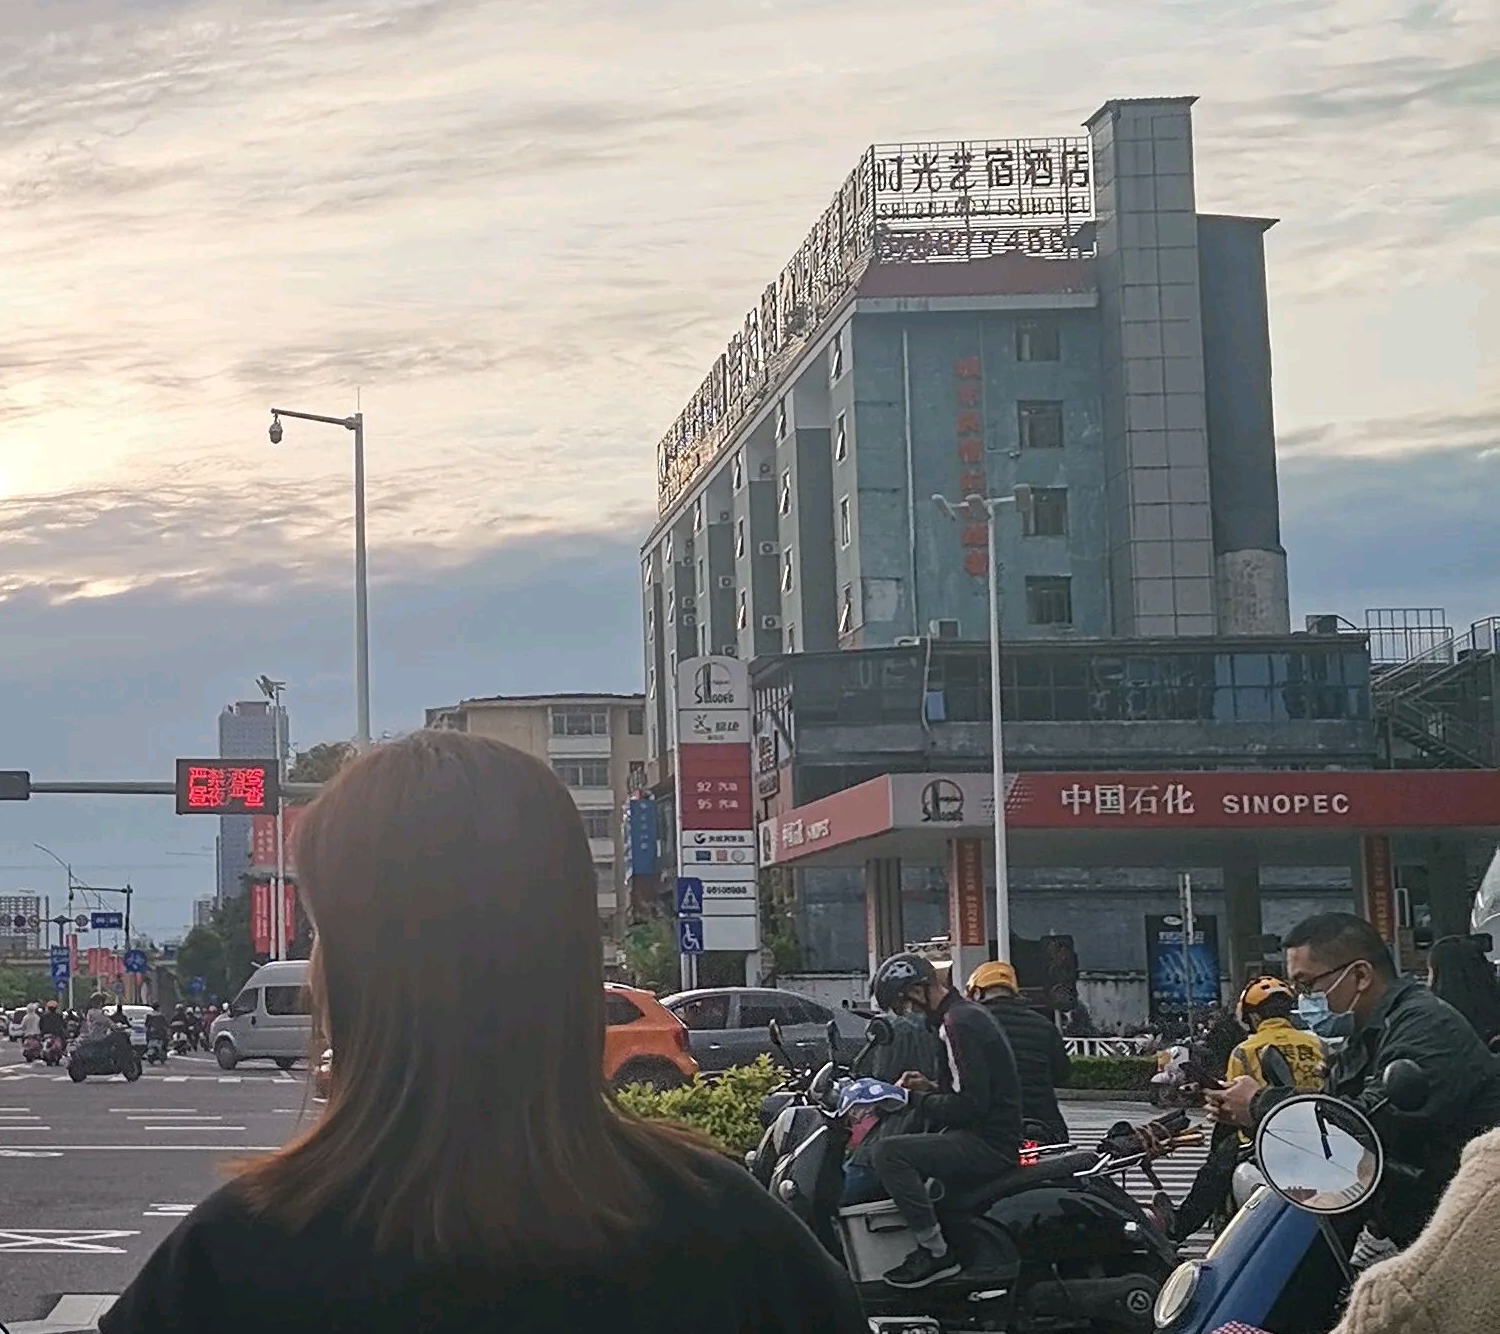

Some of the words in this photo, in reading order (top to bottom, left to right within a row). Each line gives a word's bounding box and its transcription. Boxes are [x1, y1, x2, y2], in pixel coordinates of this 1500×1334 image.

[876, 147, 1090, 194] 时光艺宿酒店
[1060, 783, 1195, 816] 中国石化
[1221, 793, 1351, 815] SINOPEC
